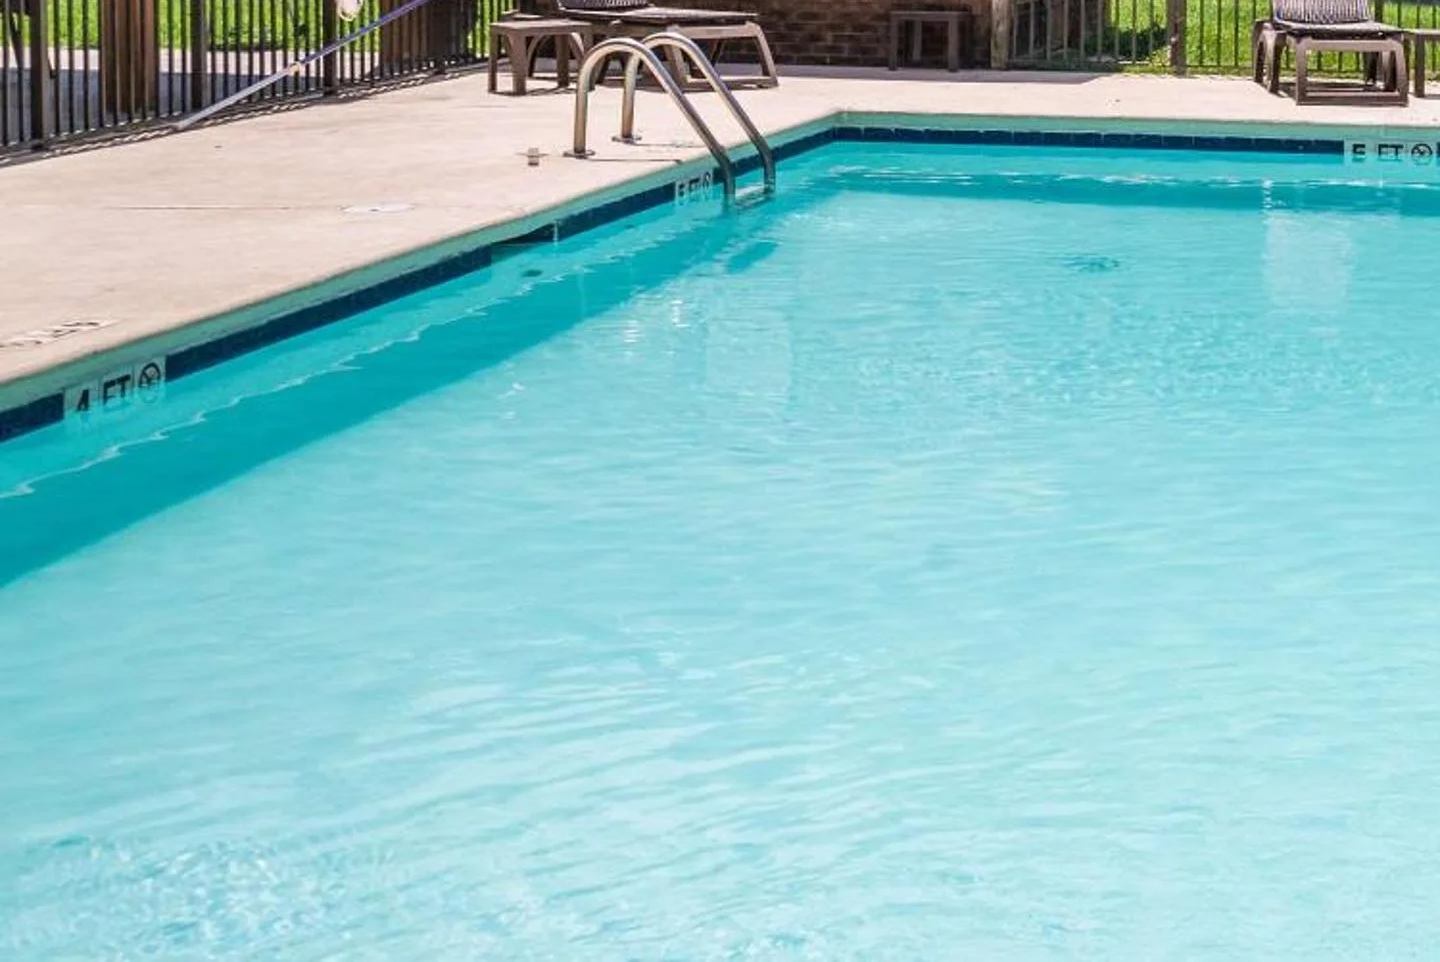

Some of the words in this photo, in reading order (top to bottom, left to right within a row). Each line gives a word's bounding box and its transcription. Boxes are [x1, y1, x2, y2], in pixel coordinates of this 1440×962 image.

[1378, 143, 1403, 160] FT
[76, 389, 90, 412] 4
[103, 374, 131, 406] FT
